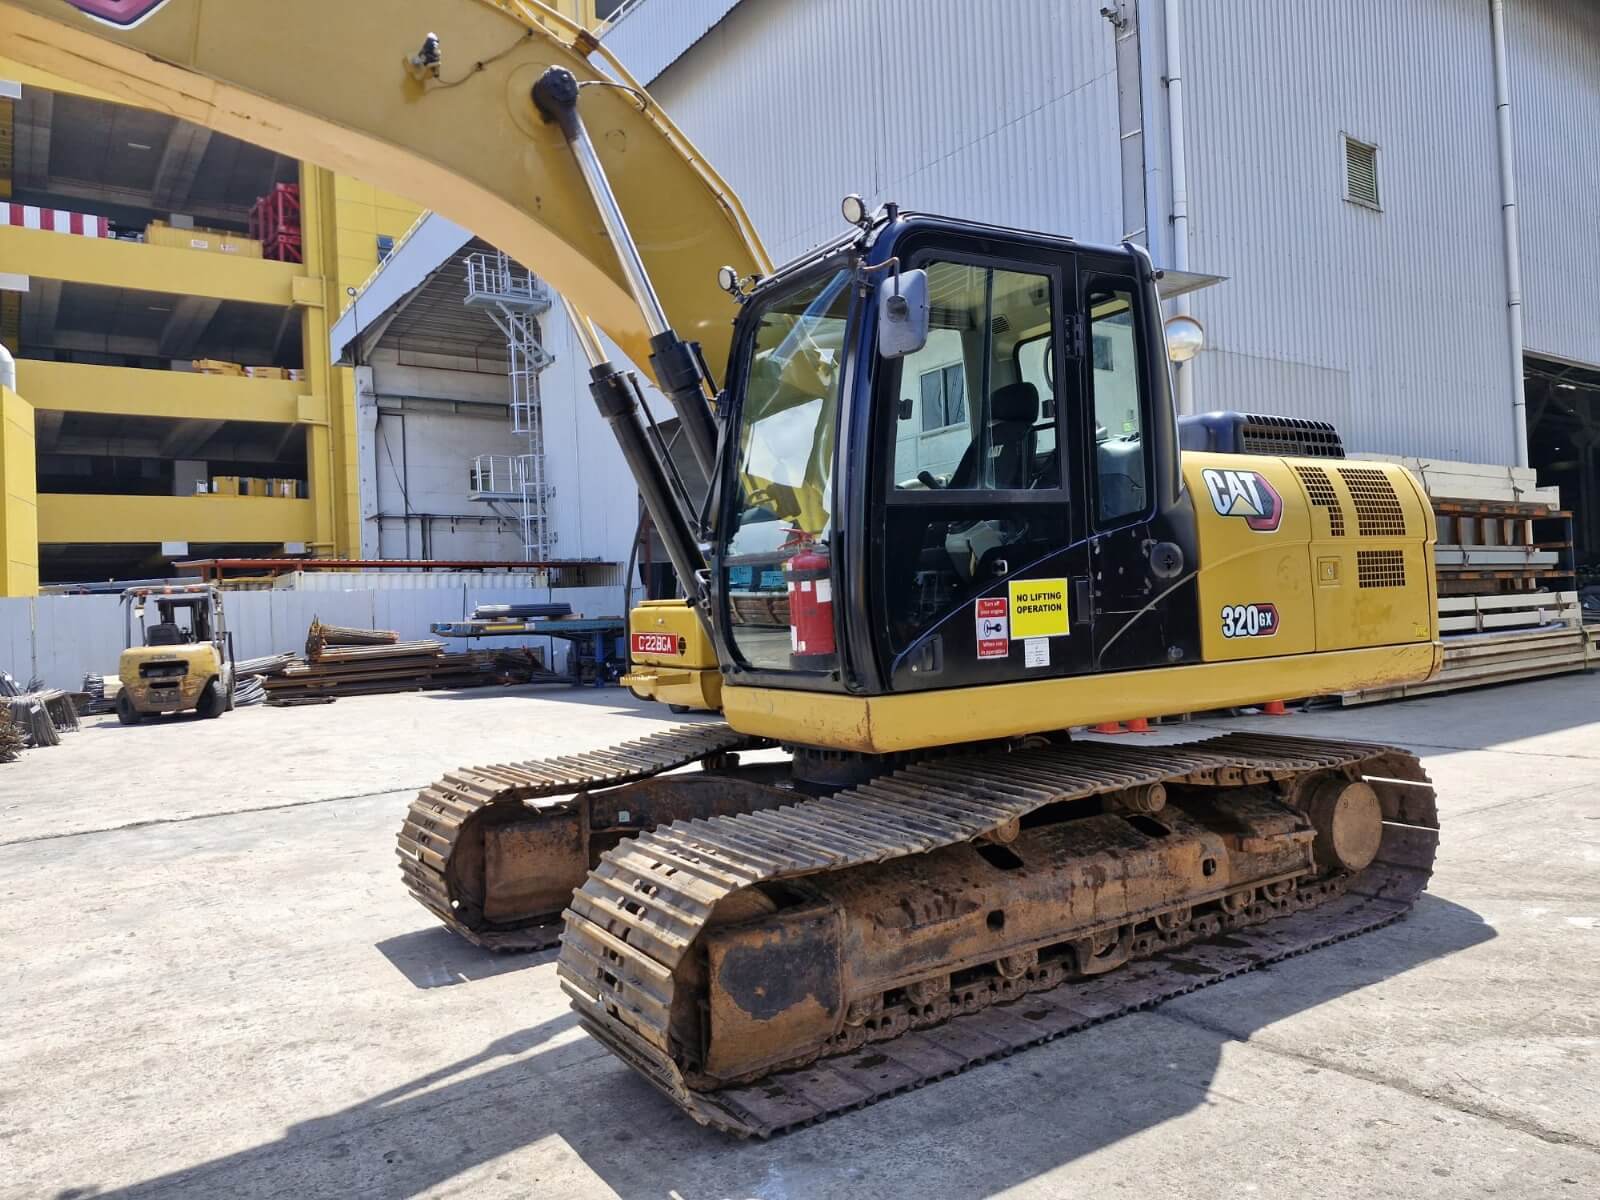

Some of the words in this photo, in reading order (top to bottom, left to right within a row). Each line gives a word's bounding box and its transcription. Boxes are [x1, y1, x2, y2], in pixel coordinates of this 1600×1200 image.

[1203, 469, 1265, 516] CAT
[1016, 594, 1029, 603] NO
[1030, 592, 1062, 602] LIFTING
[1016, 604, 1062, 614] OPERATION
